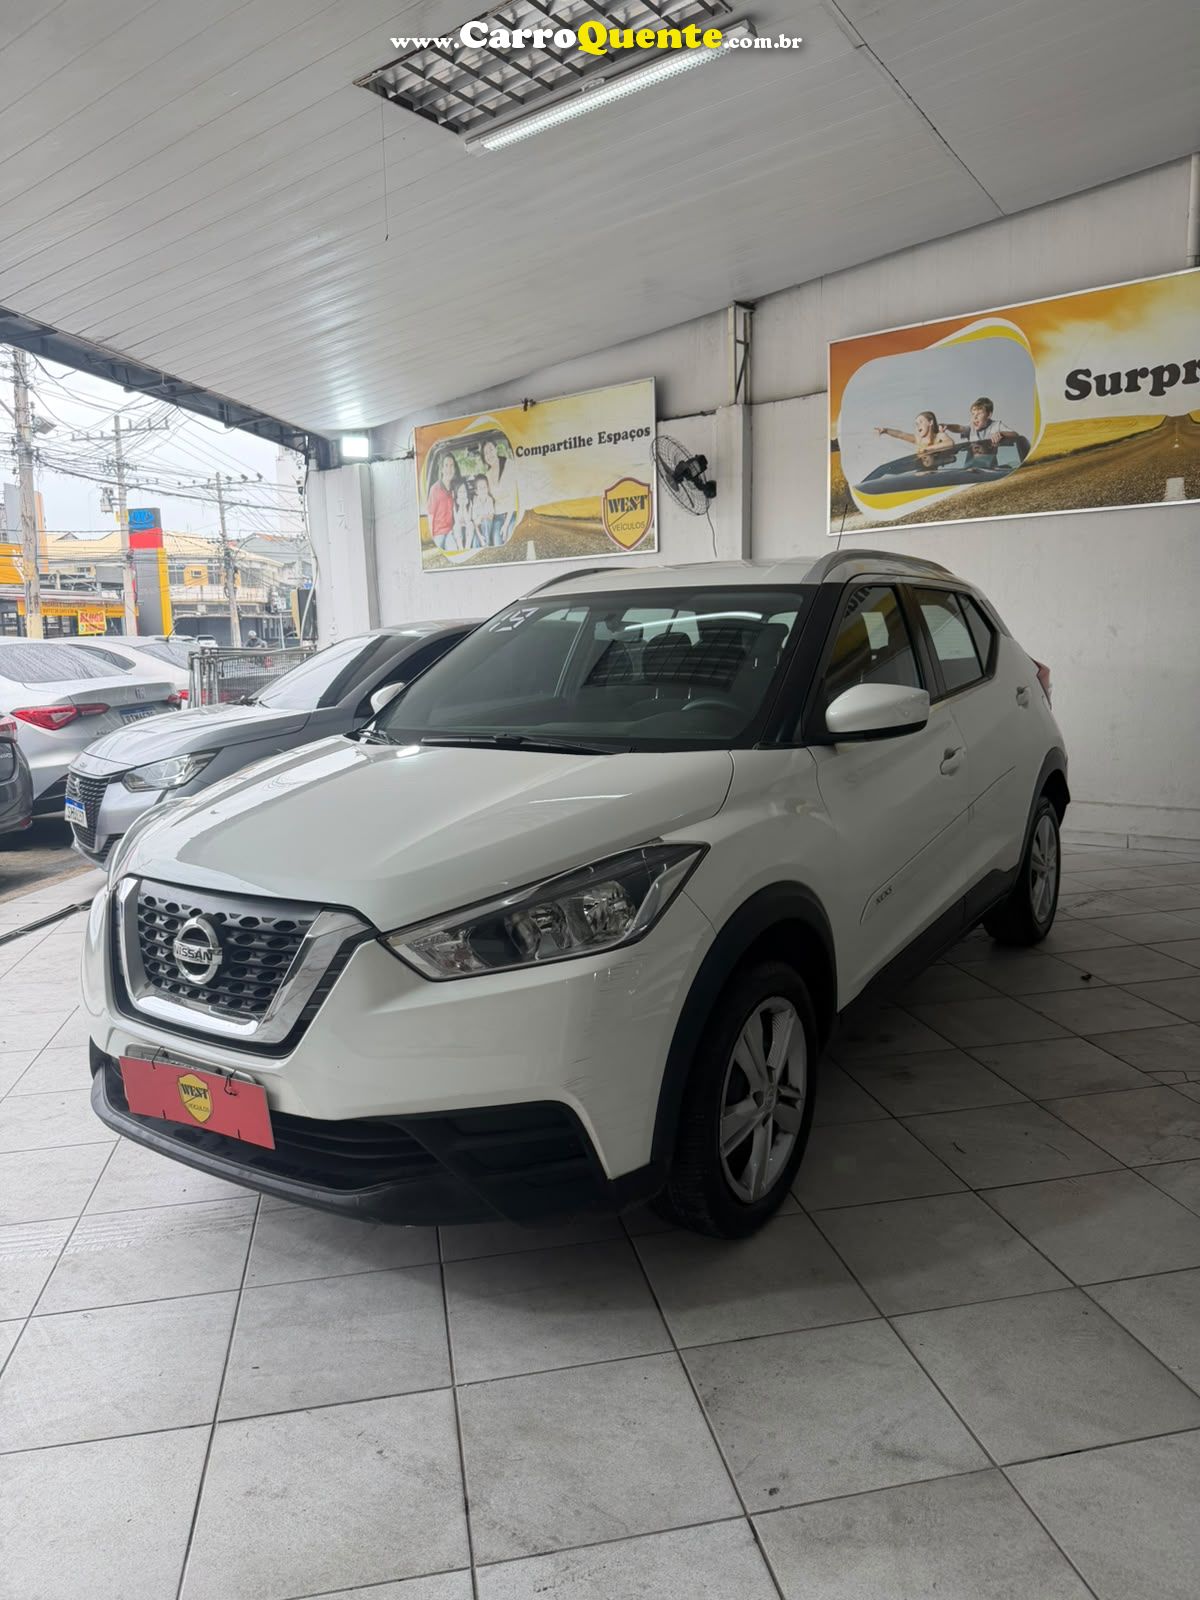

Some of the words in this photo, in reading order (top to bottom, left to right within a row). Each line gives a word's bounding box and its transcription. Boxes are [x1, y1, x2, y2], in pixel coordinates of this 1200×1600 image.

[1064, 359, 1200, 402] Surpr
[515, 435, 593, 458] Compartilhe
[597, 426, 651, 445] Espaços
[608, 495, 648, 514] WEST
[175, 943, 213, 961] NISSAN
[180, 1083, 208, 1099] WEST
